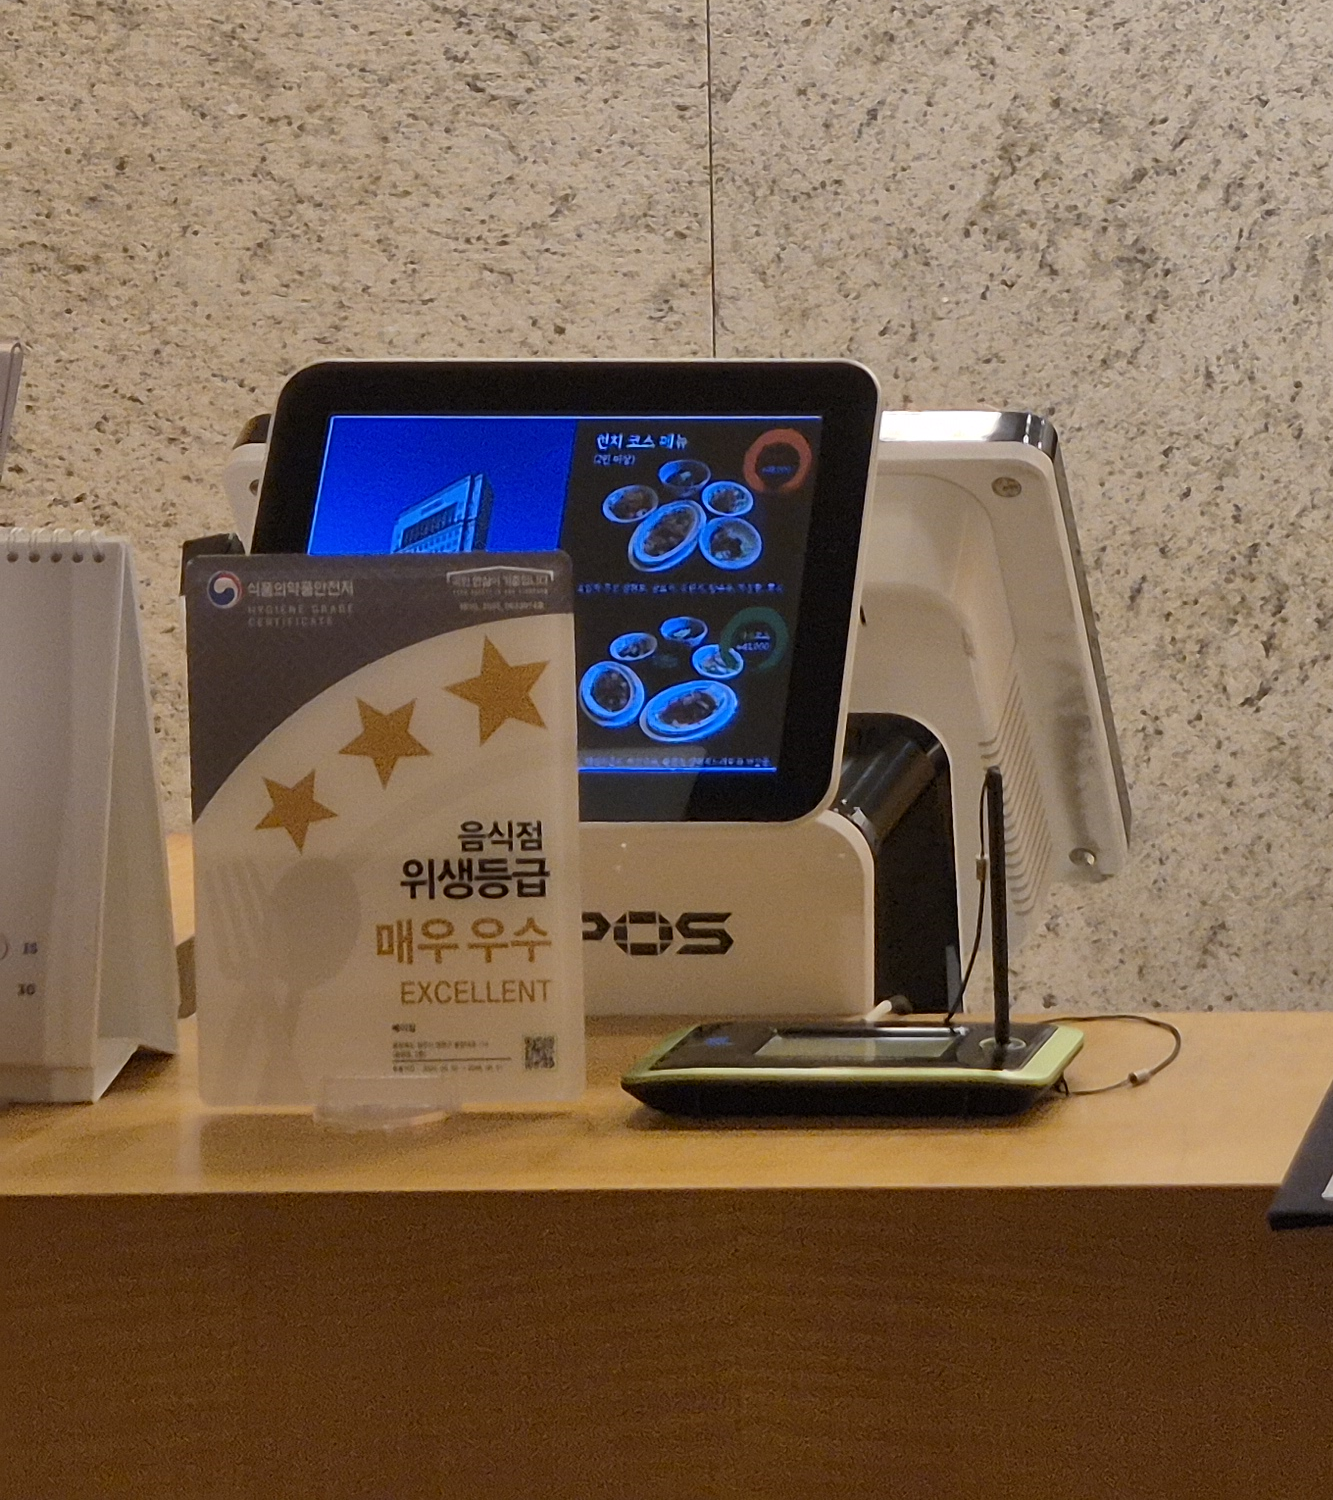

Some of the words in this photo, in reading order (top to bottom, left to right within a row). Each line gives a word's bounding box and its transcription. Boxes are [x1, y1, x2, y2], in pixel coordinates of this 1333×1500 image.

[457, 820, 543, 851] 음식점
[400, 858, 551, 900] 위생등급
[375, 918, 460, 965] 매우
[467, 917, 552, 964] 우수
[400, 979, 553, 1005] EXCELLENT
